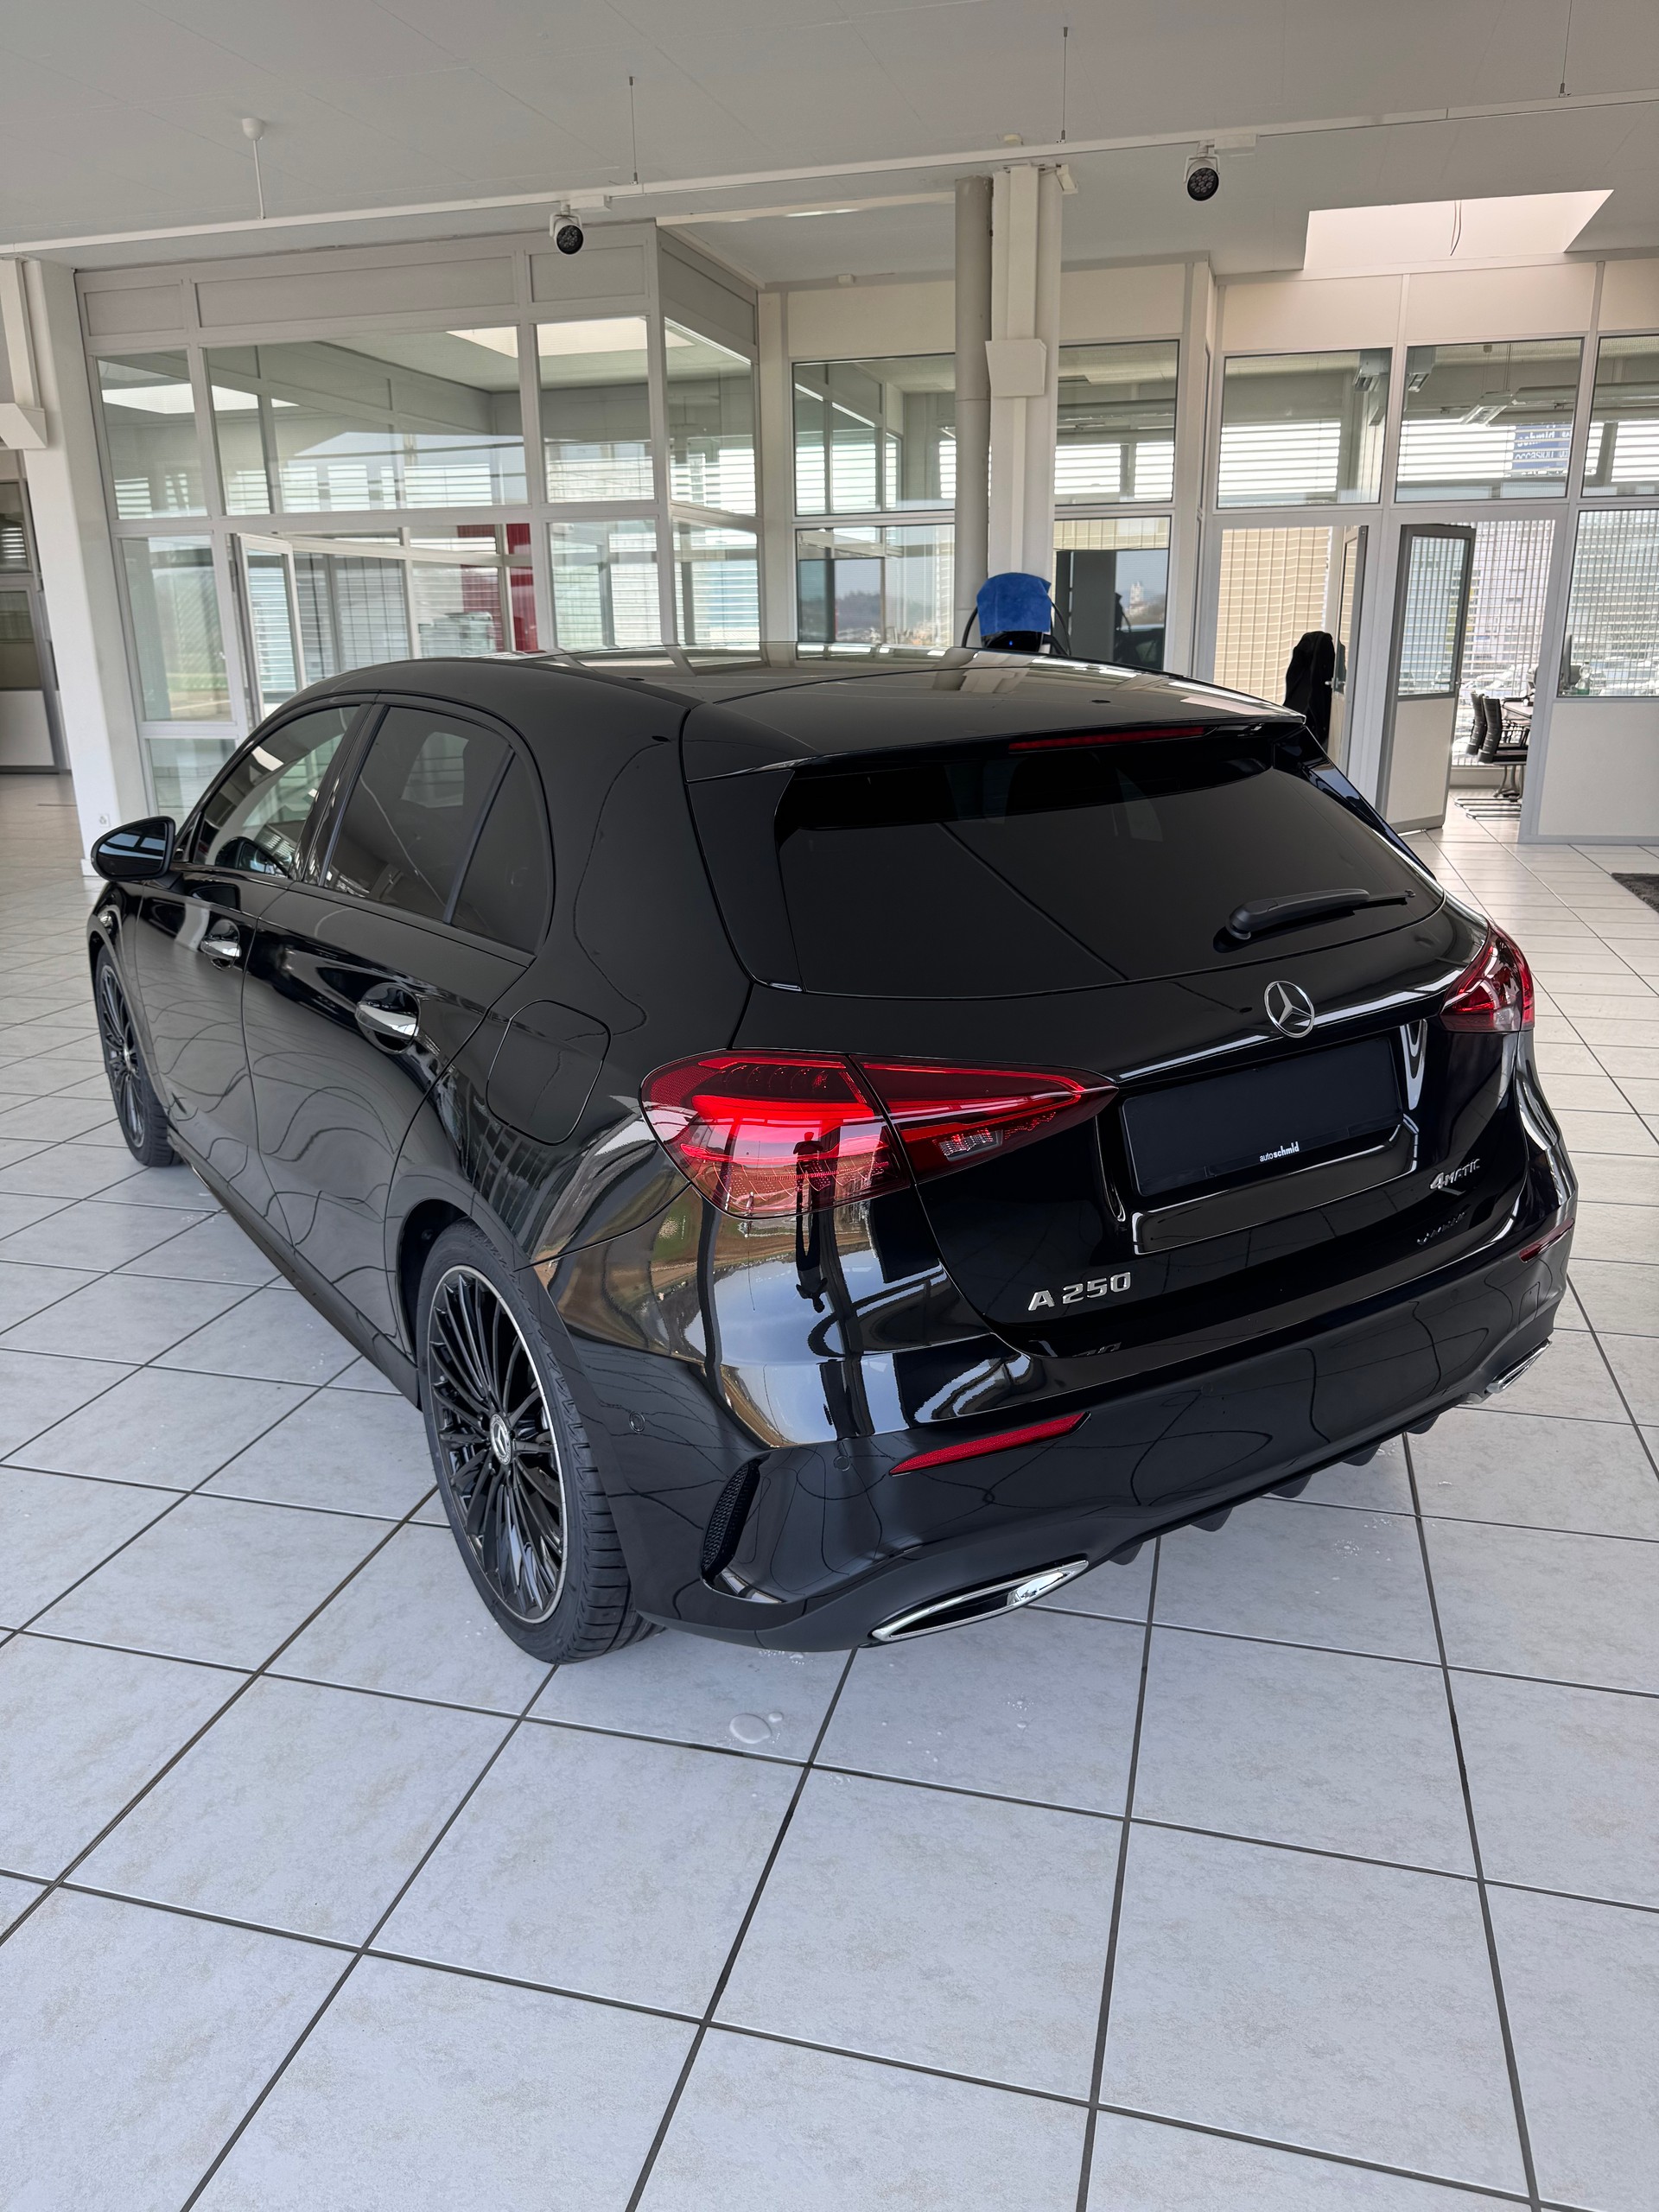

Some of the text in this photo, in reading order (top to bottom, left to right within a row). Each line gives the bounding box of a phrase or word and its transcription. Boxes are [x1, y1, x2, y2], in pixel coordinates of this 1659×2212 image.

[1429, 1158, 1480, 1190] 4MATIC
[1027, 1271, 1132, 1312] A 250
